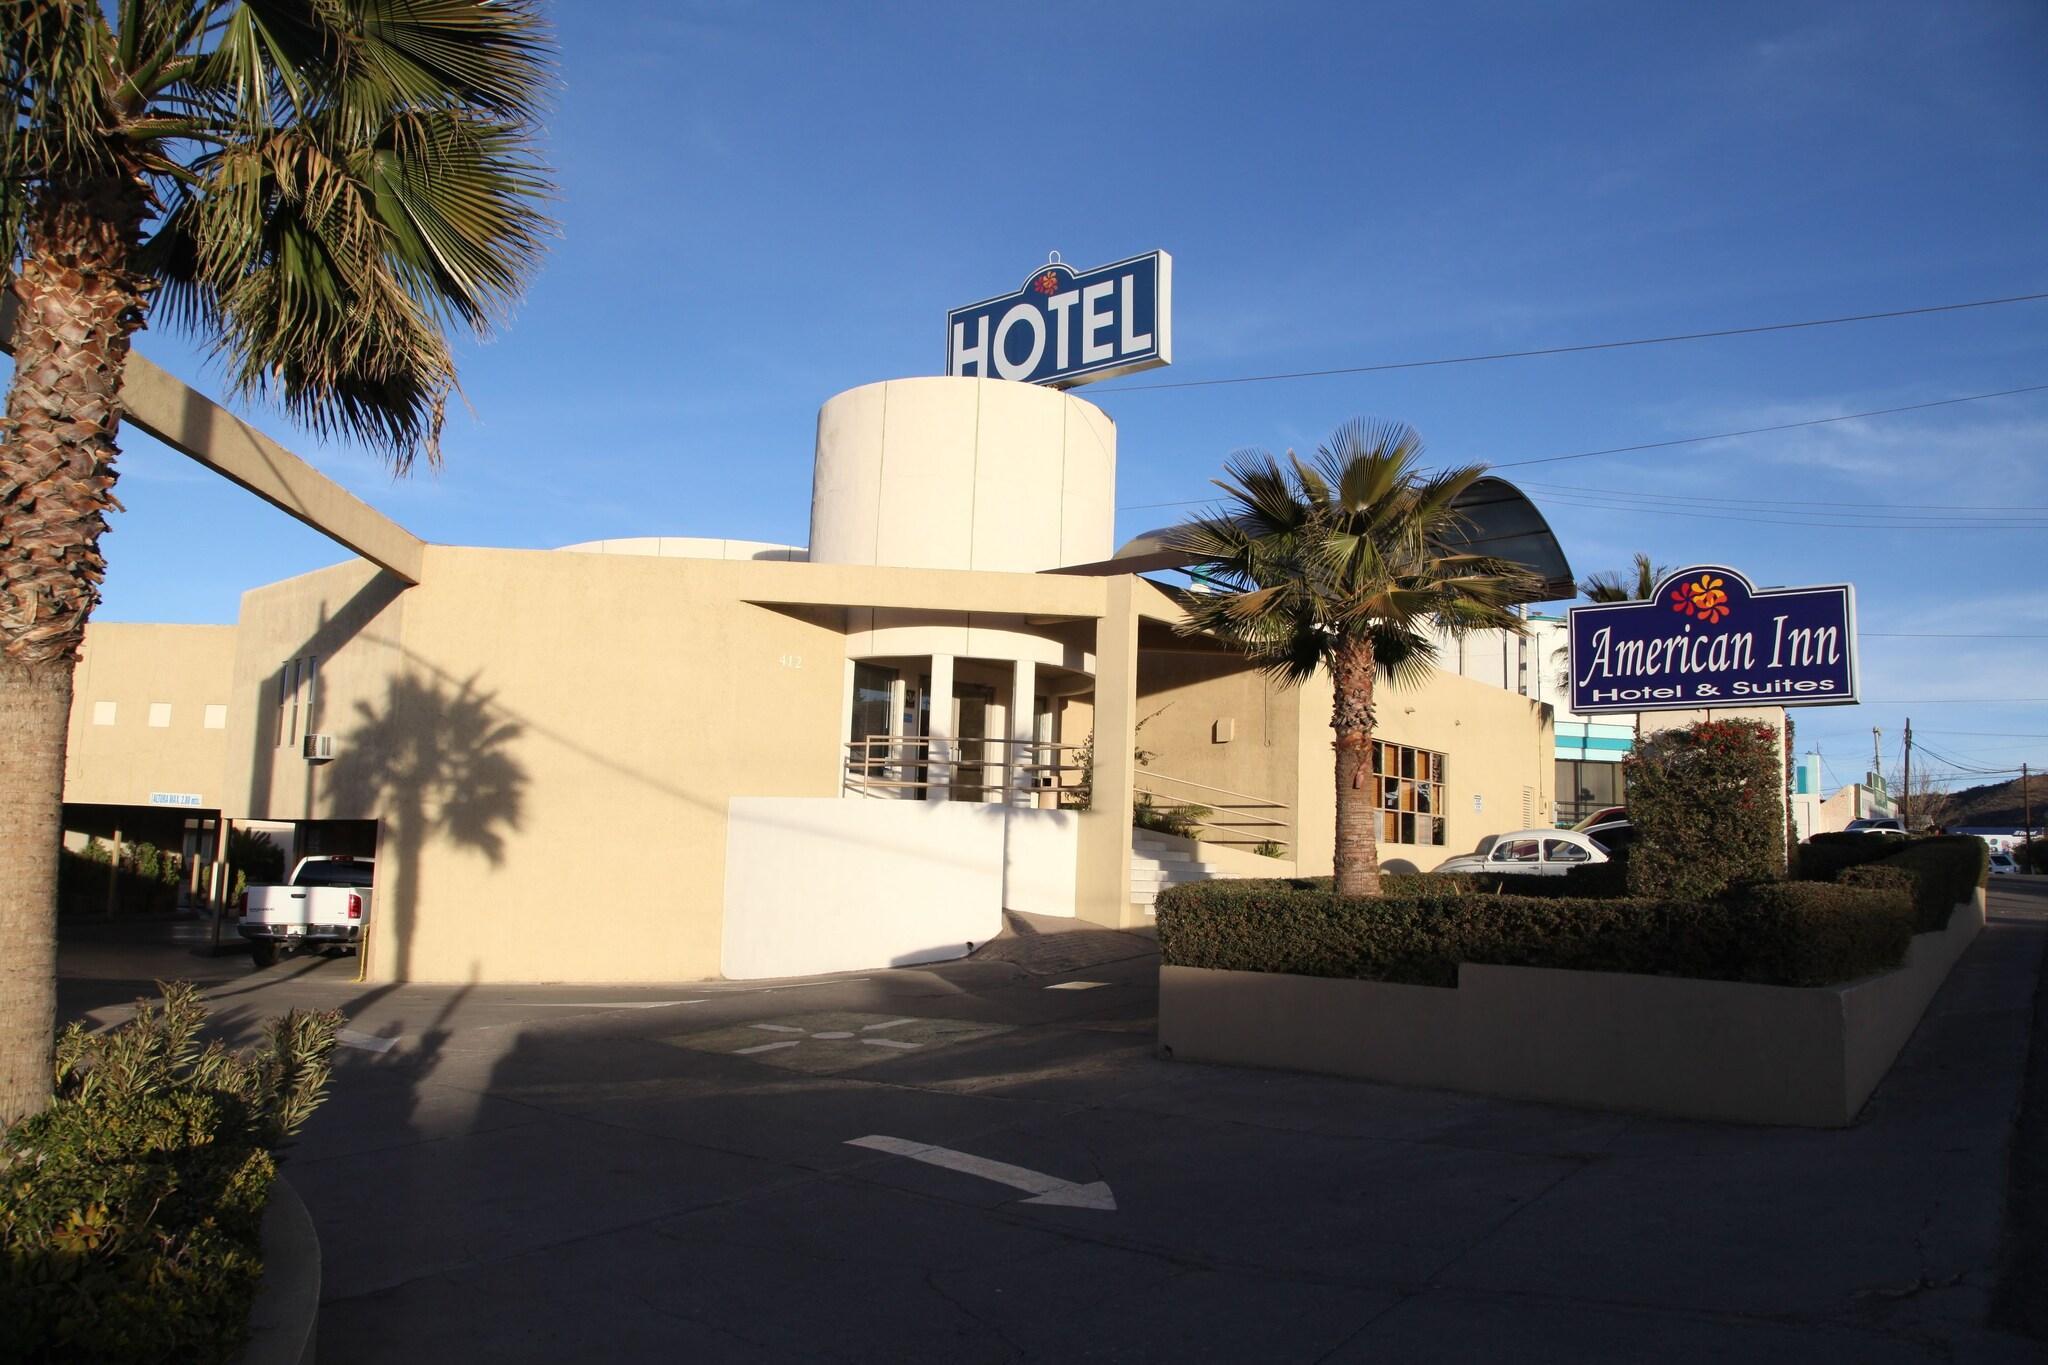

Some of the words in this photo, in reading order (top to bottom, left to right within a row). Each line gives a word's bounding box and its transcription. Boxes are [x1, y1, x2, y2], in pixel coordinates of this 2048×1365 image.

[953, 274, 1152, 382] HOTEL
[1579, 623, 1755, 687] American
[1767, 615, 1840, 669] Inn
[1592, 685, 1682, 702] Hotel
[1695, 683, 1720, 697] &
[1732, 678, 1835, 695] Suites
